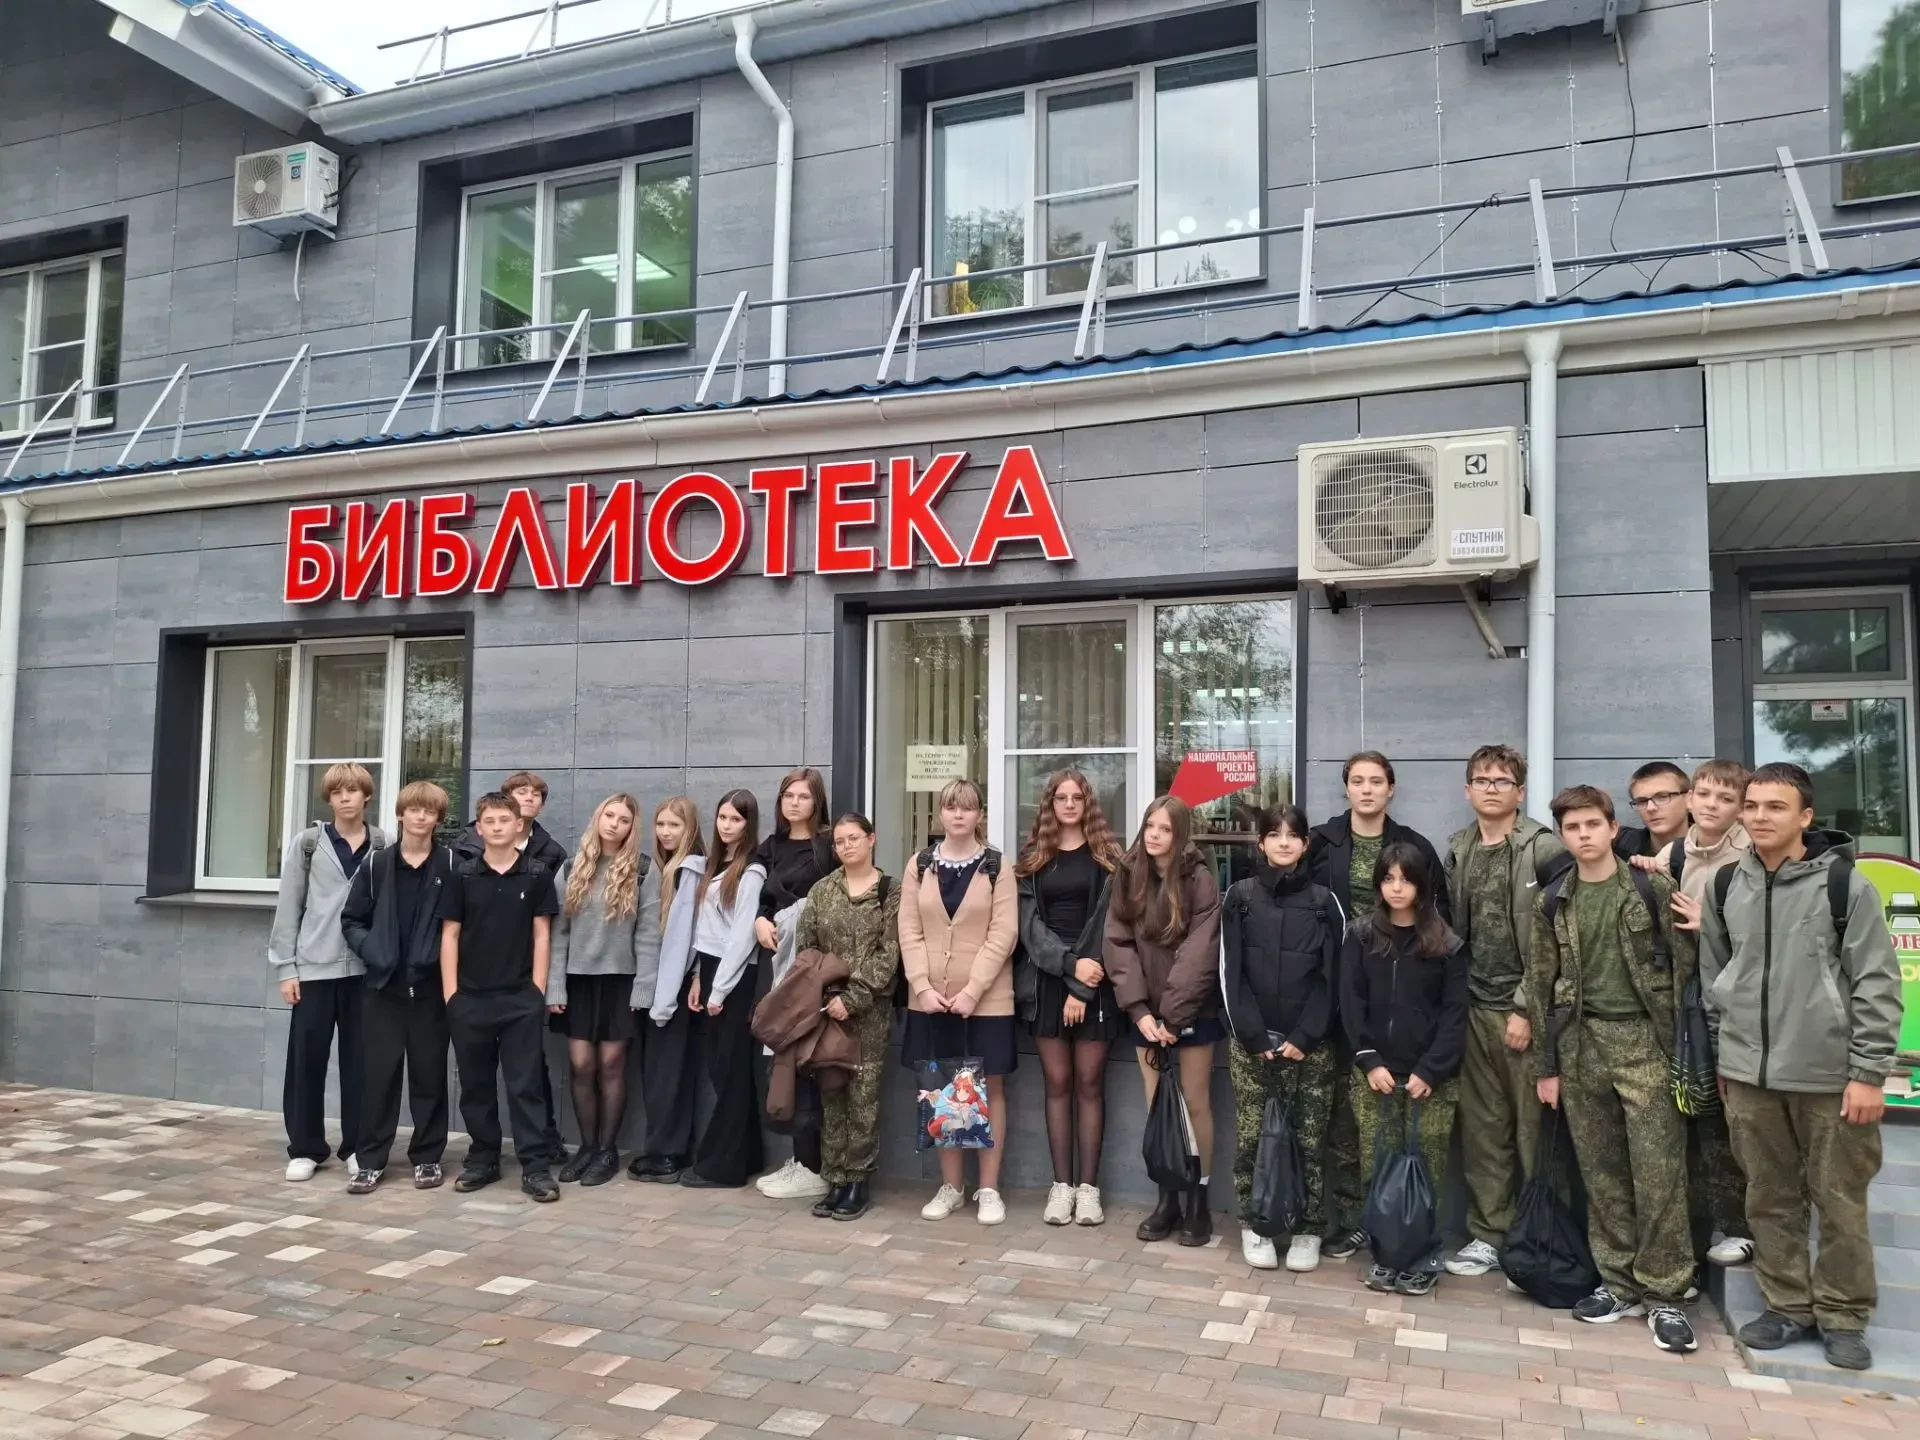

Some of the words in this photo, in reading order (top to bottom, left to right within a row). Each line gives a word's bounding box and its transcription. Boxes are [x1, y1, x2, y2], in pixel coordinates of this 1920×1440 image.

[1453, 480, 1499, 489] Electrolux
[284, 445, 1076, 604] БИБЛИОТЕКА
[1459, 531, 1504, 544] СПУТНИК
[1188, 751, 1256, 763] НАЦИОНАЛЬНЫЕ
[1216, 762, 1256, 773] ПРОЕКТЫ
[1224, 772, 1256, 782] РОССИИ
